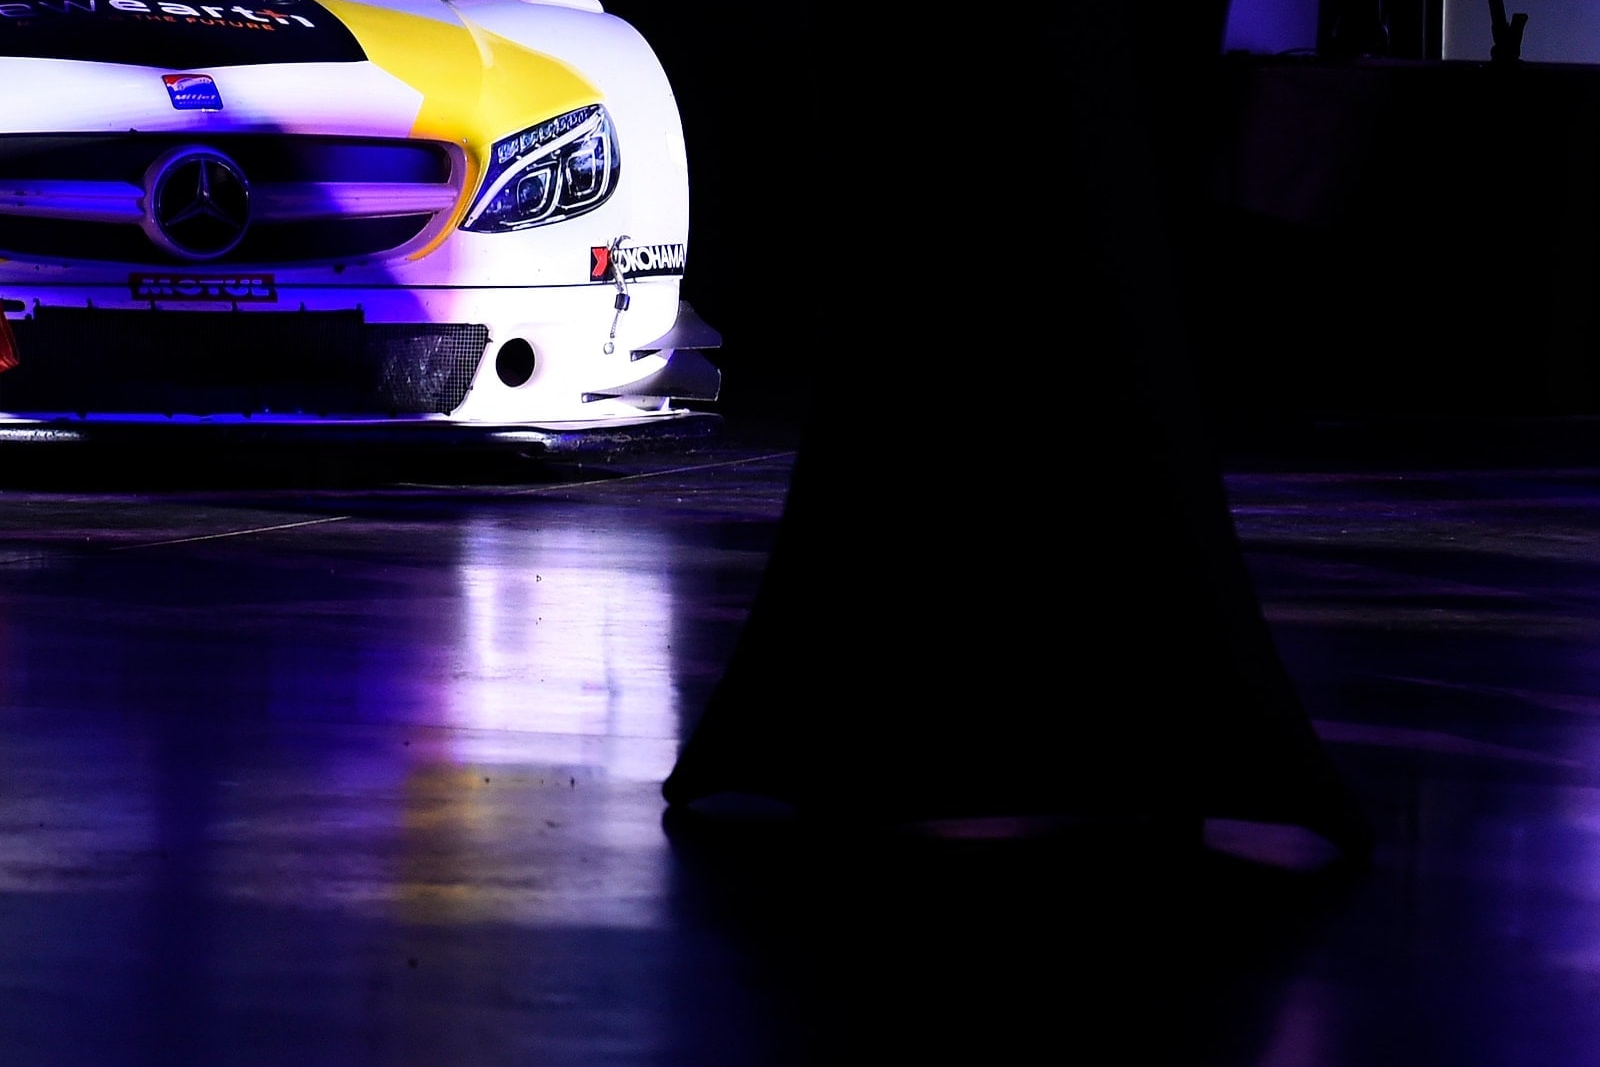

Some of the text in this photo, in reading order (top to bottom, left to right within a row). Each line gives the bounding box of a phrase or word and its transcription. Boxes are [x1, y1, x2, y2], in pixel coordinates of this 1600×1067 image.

[134, 14, 178, 23] THE
[186, 17, 276, 31] FUTURE
[137, 278, 271, 297] MOTUL
